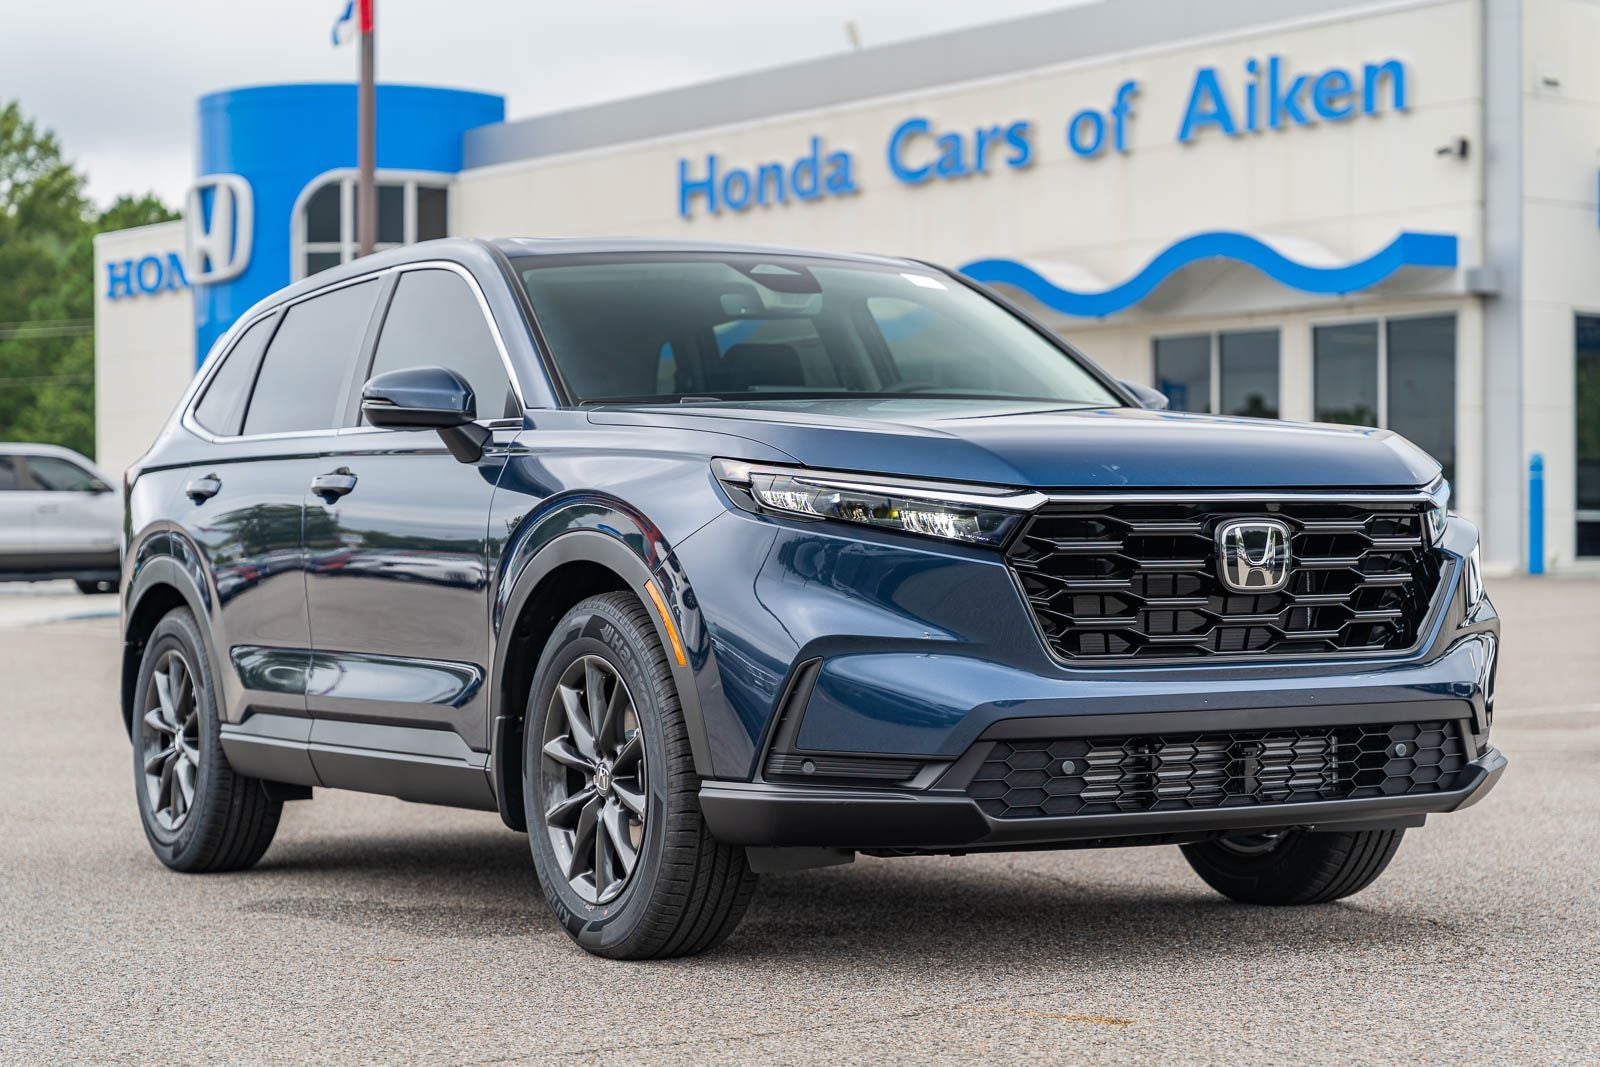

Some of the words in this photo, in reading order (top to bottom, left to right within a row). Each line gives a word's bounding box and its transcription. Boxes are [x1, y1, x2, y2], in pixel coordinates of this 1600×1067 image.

[679, 136, 857, 219] Honda
[887, 116, 1032, 185] Cars
[1066, 80, 1137, 157] of
[1177, 55, 1406, 144] Aiken
